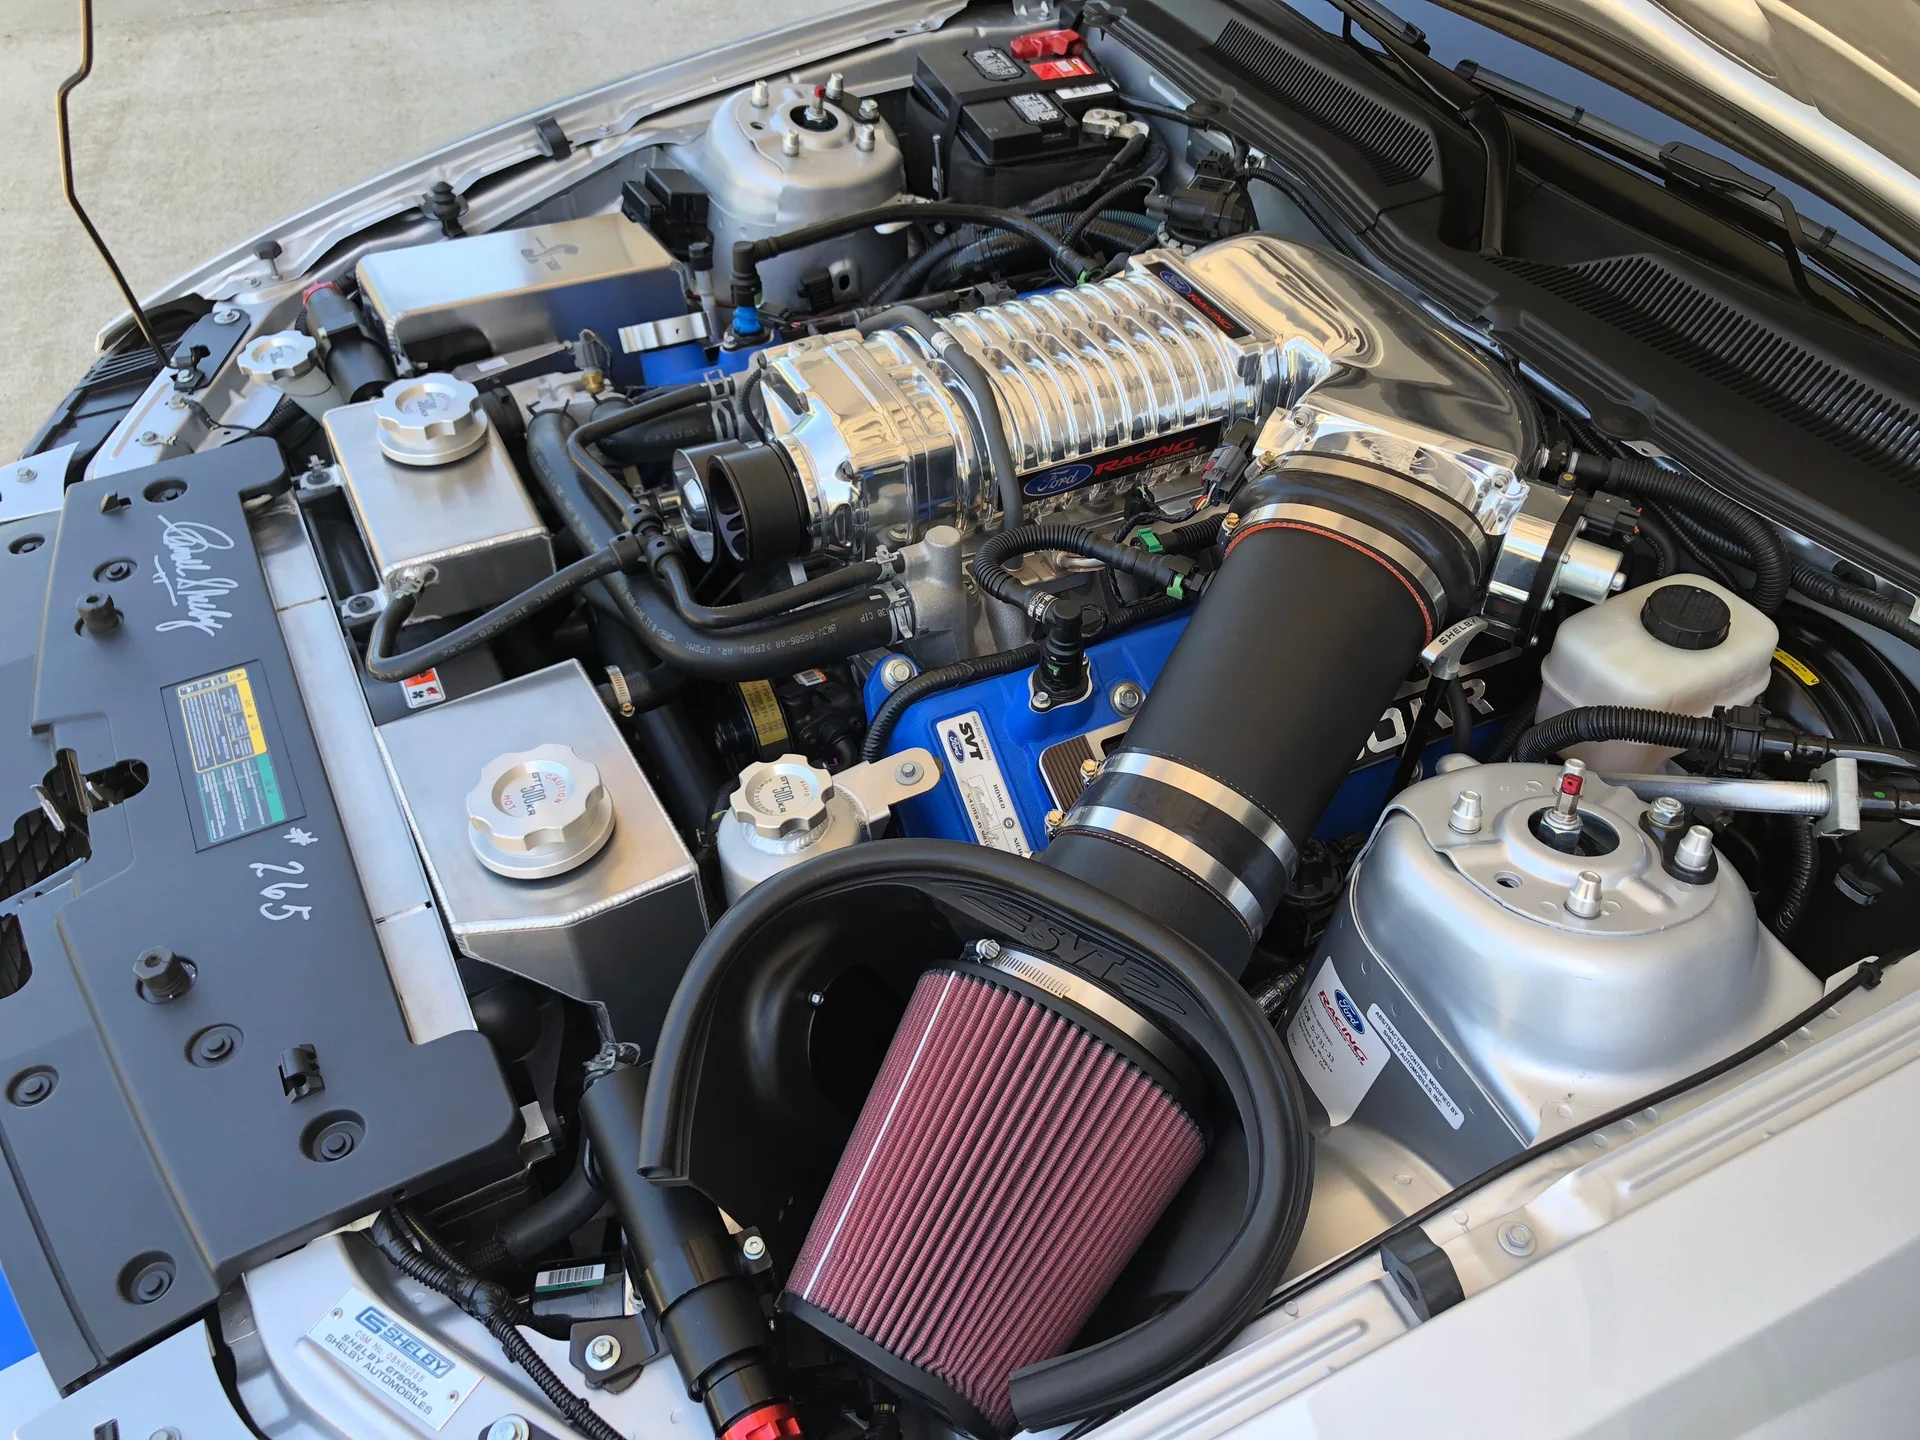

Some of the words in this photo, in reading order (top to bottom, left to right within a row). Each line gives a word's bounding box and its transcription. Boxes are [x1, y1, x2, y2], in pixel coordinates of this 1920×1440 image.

[1187, 293, 1235, 330] RACING
[1037, 469, 1079, 492] Ford
[1094, 437, 1197, 476] RACING
[860, 612, 874, 623] CIP
[1438, 618, 1477, 646] SHELBY
[949, 734, 963, 758] Ford
[959, 722, 984, 760] SVT
[504, 794, 517, 811] HOT
[520, 772, 547, 816] GT500KR
[545, 773, 567, 804] CAUTION
[753, 795, 774, 815] STEERING
[756, 778, 773, 795] POWER
[772, 776, 795, 814] GT500KR
[800, 780, 810, 797] FLUID
[993, 784, 1005, 809] ROMEO
[1024, 918, 1127, 979] SVT
[1319, 990, 1368, 1061] RACING
[1338, 998, 1360, 1028] Ford
[1311, 1025, 1334, 1063] D-231-33
[1375, 1011, 1408, 1052] ABS/TRACTION
[1406, 1051, 1428, 1079] CONTROL
[1428, 1078, 1451, 1107] MODIFIED
[1450, 1107, 1459, 1116] BY
[1382, 1029, 1401, 1053] SHELBY
[1400, 1052, 1433, 1096] AUTOMOBILES,
[1432, 1093, 1443, 1108] INC.
[354, 1329, 371, 1344] CSM
[373, 1342, 385, 1356] No.
[383, 1326, 449, 1372] SHELBY
[324, 1333, 364, 1364] SHELBY
[363, 1363, 433, 1416] AUTOMOBILES
[341, 1333, 384, 1365] SHELBY
[385, 1366, 429, 1399] GT500KR
